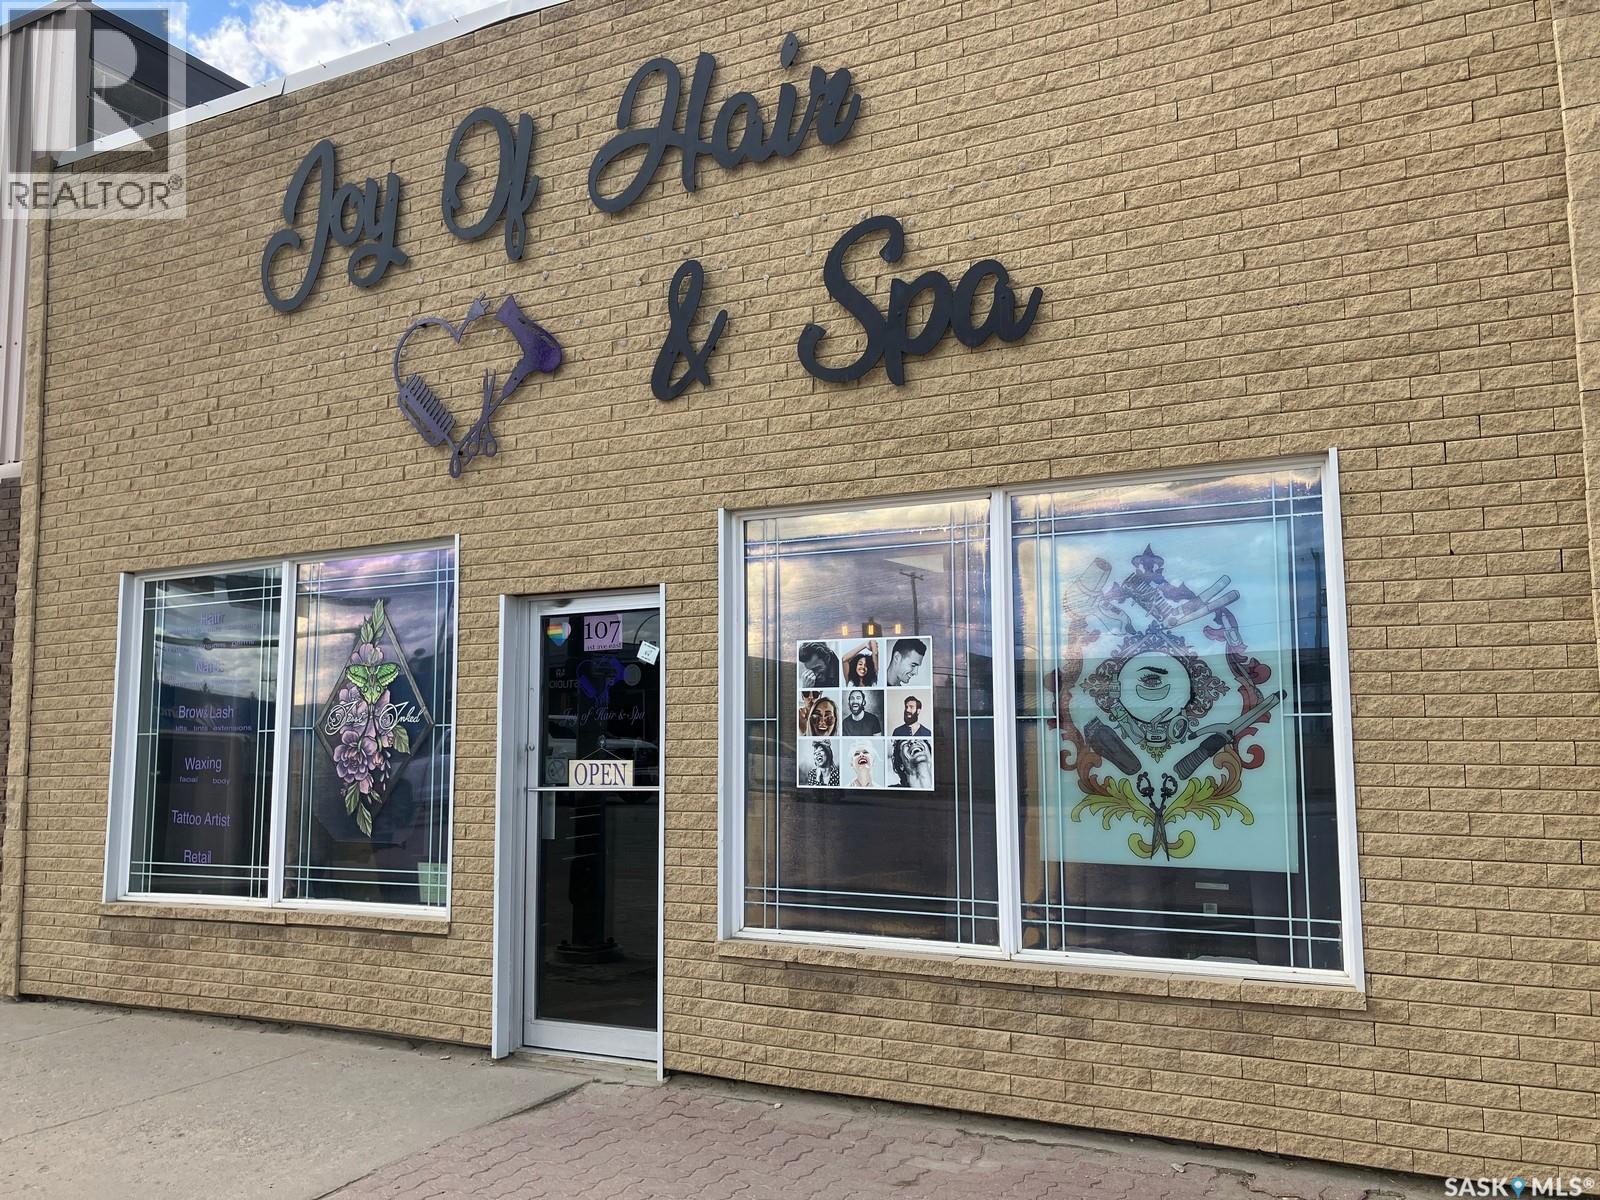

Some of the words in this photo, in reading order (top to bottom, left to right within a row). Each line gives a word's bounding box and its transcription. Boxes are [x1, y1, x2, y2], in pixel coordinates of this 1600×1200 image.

[262, 138, 409, 313] Joy
[442, 106, 540, 262] Of
[588, 32, 862, 214] Hair
[651, 260, 728, 401] &
[798, 215, 1044, 386] Spa
[584, 620, 622, 643] 107
[212, 724, 253, 732] extensions
[184, 756, 222, 772] Waxing
[212, 777, 231, 785] body
[574, 762, 628, 786] OPEN
[171, 809, 202, 826] Tattoo
[203, 811, 231, 828] Artist
[183, 849, 212, 864] Retail
